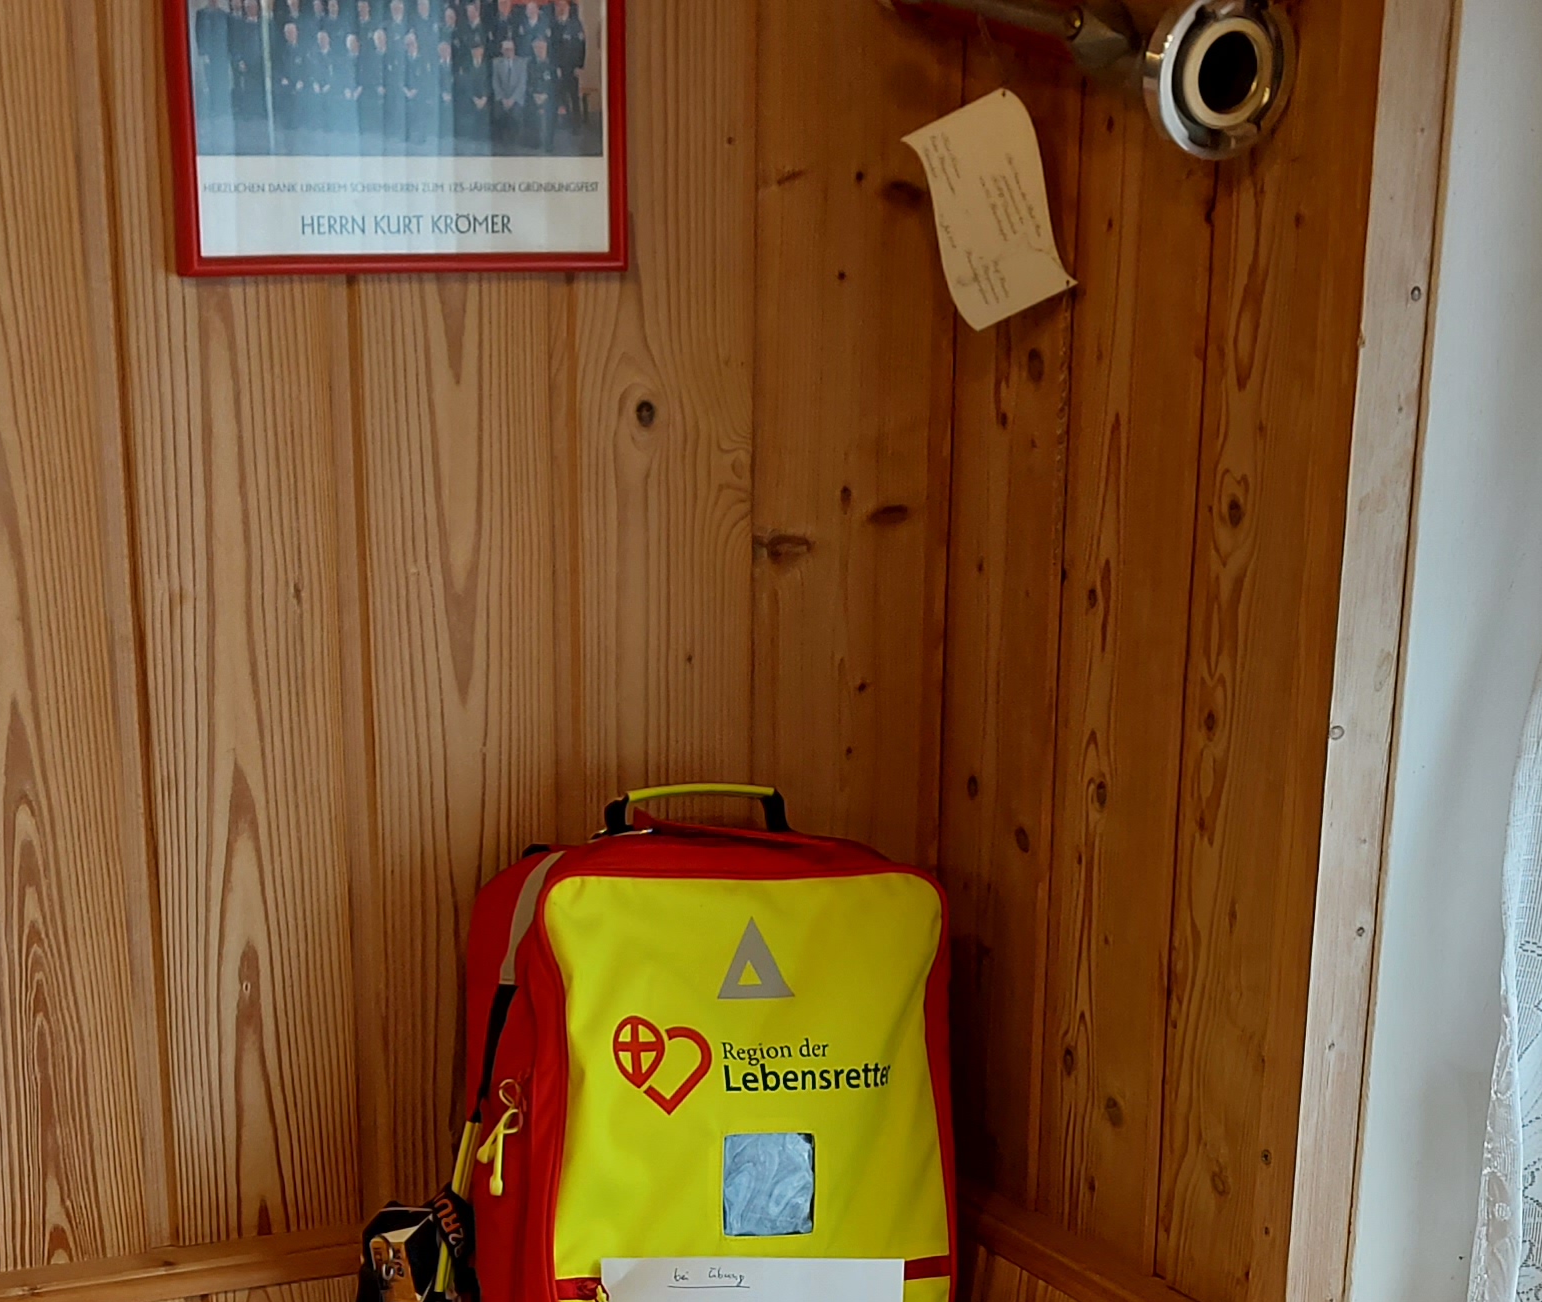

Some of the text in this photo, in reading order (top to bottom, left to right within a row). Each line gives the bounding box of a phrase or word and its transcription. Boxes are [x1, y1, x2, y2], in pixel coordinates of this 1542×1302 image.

[268, 182, 298, 193] DANK
[301, 212, 513, 236] HERRN KURT KRÖMER
[721, 1037, 829, 1067] Region der
[673, 1268, 690, 1282] bei
